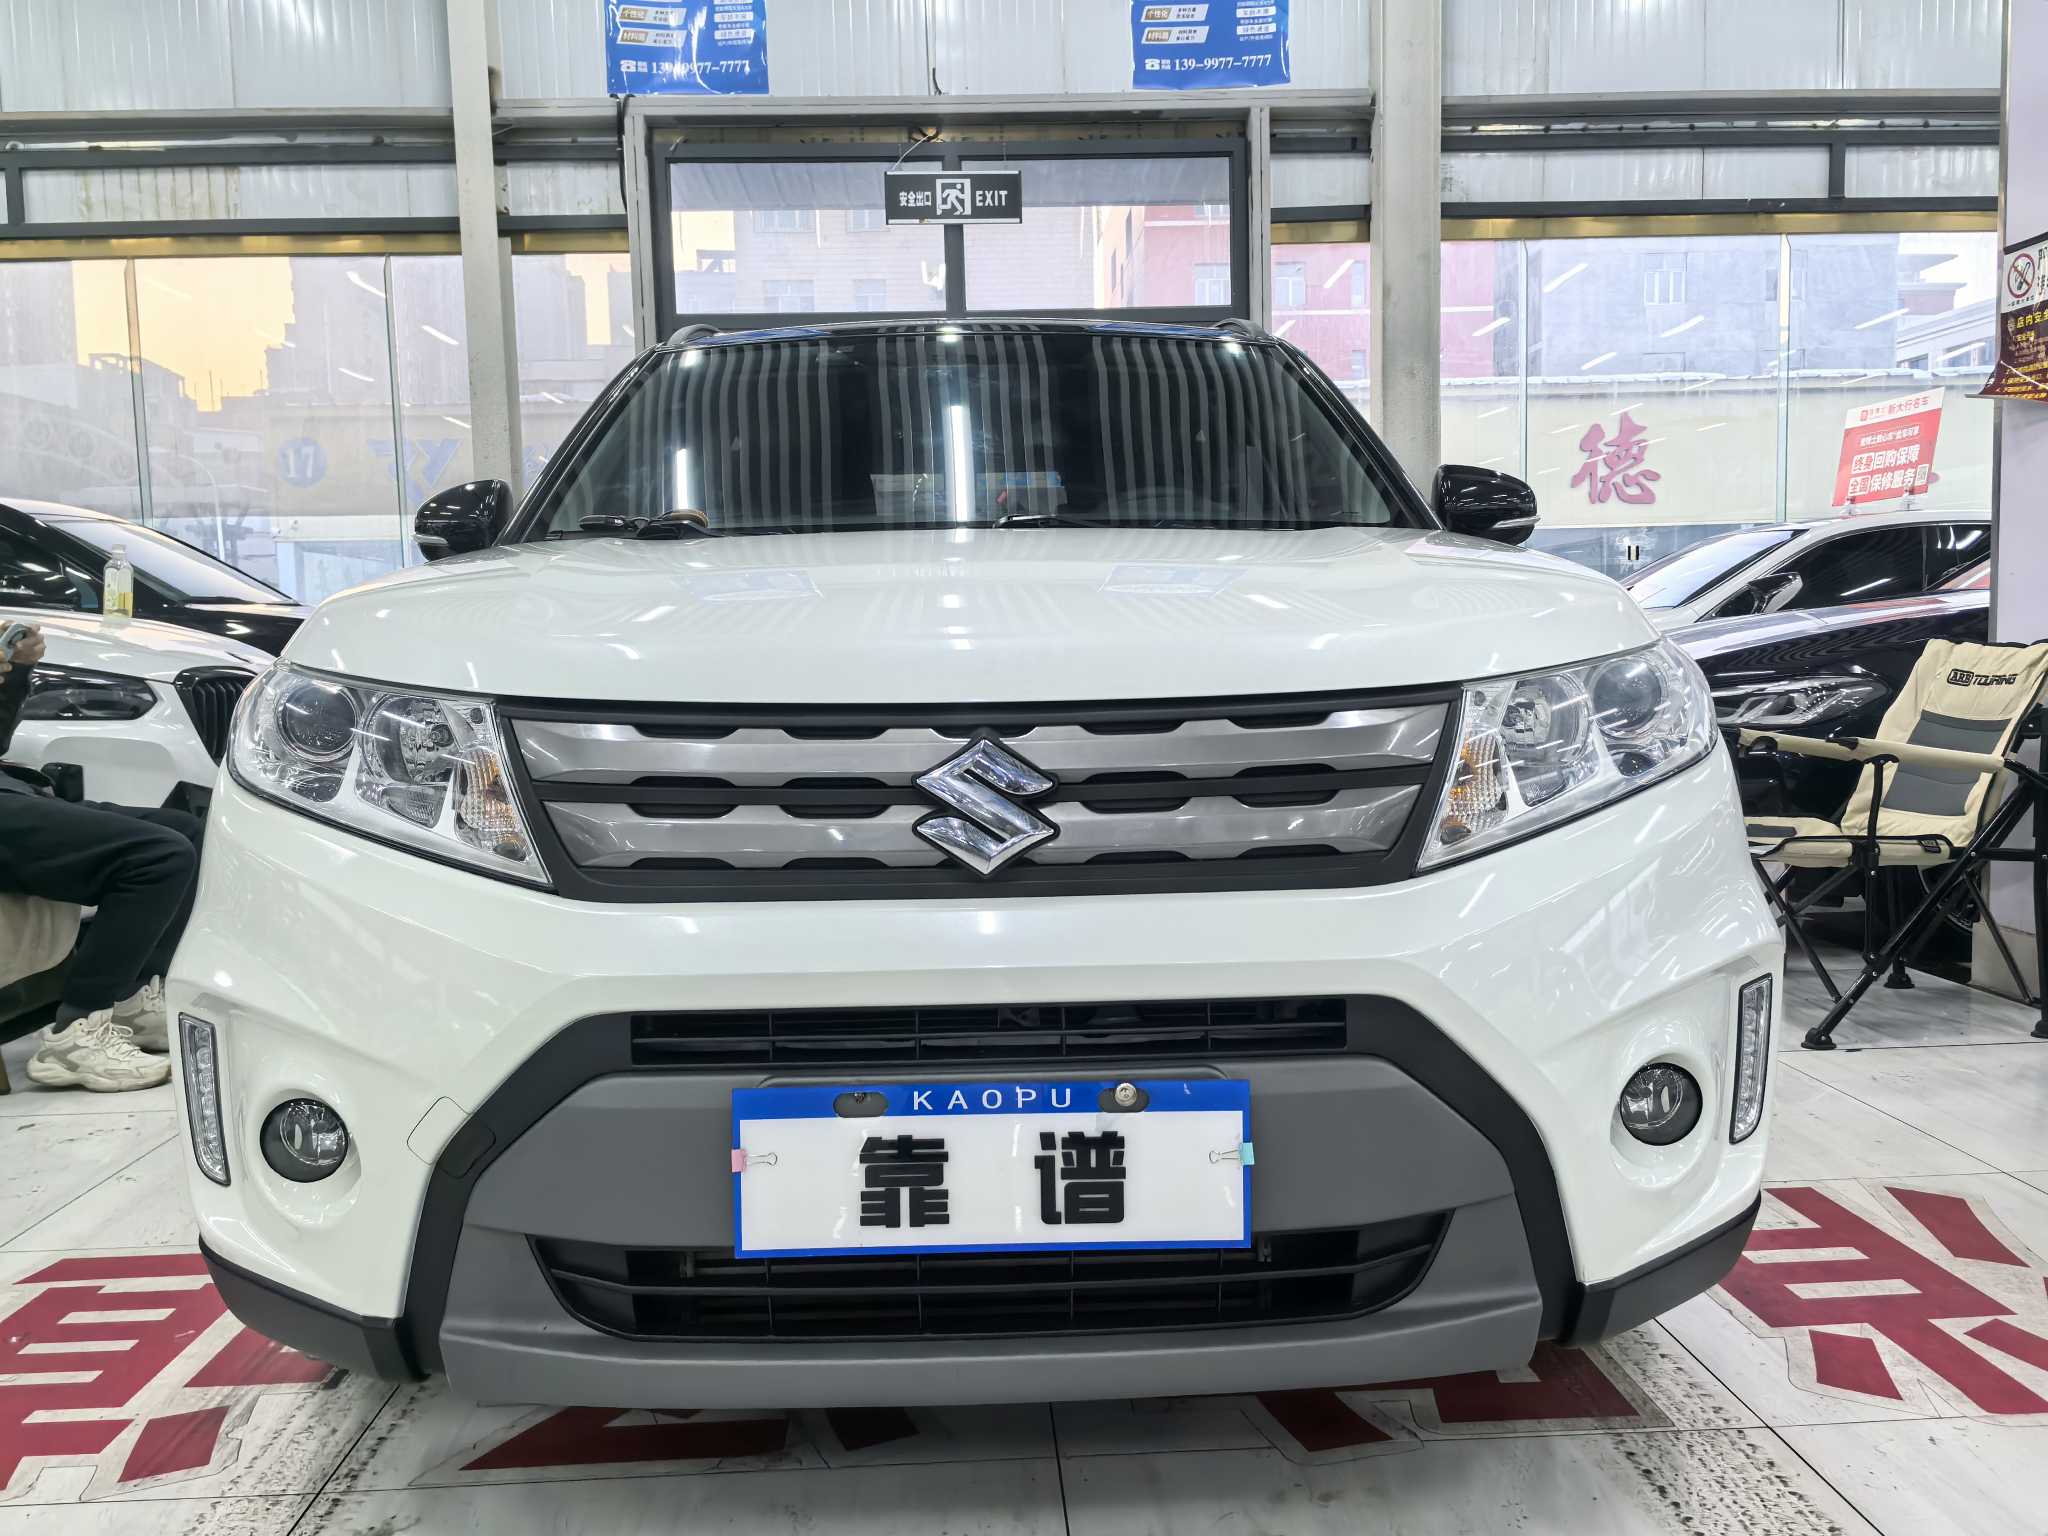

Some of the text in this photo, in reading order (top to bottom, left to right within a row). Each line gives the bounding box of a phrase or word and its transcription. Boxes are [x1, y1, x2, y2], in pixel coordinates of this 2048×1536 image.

[1174, 54, 1272, 71] 139-9977-7777
[899, 191, 932, 207] 安全出口
[975, 190, 1009, 207] EXIT
[1571, 411, 1661, 504] 德
[1852, 444, 1921, 474] 终身回购保障
[1849, 468, 1916, 495] 全国保修服务
[1973, 673, 2018, 686] TOURING
[913, 1087, 1073, 1111] KAOPU
[859, 1131, 1127, 1229] 靠谱
